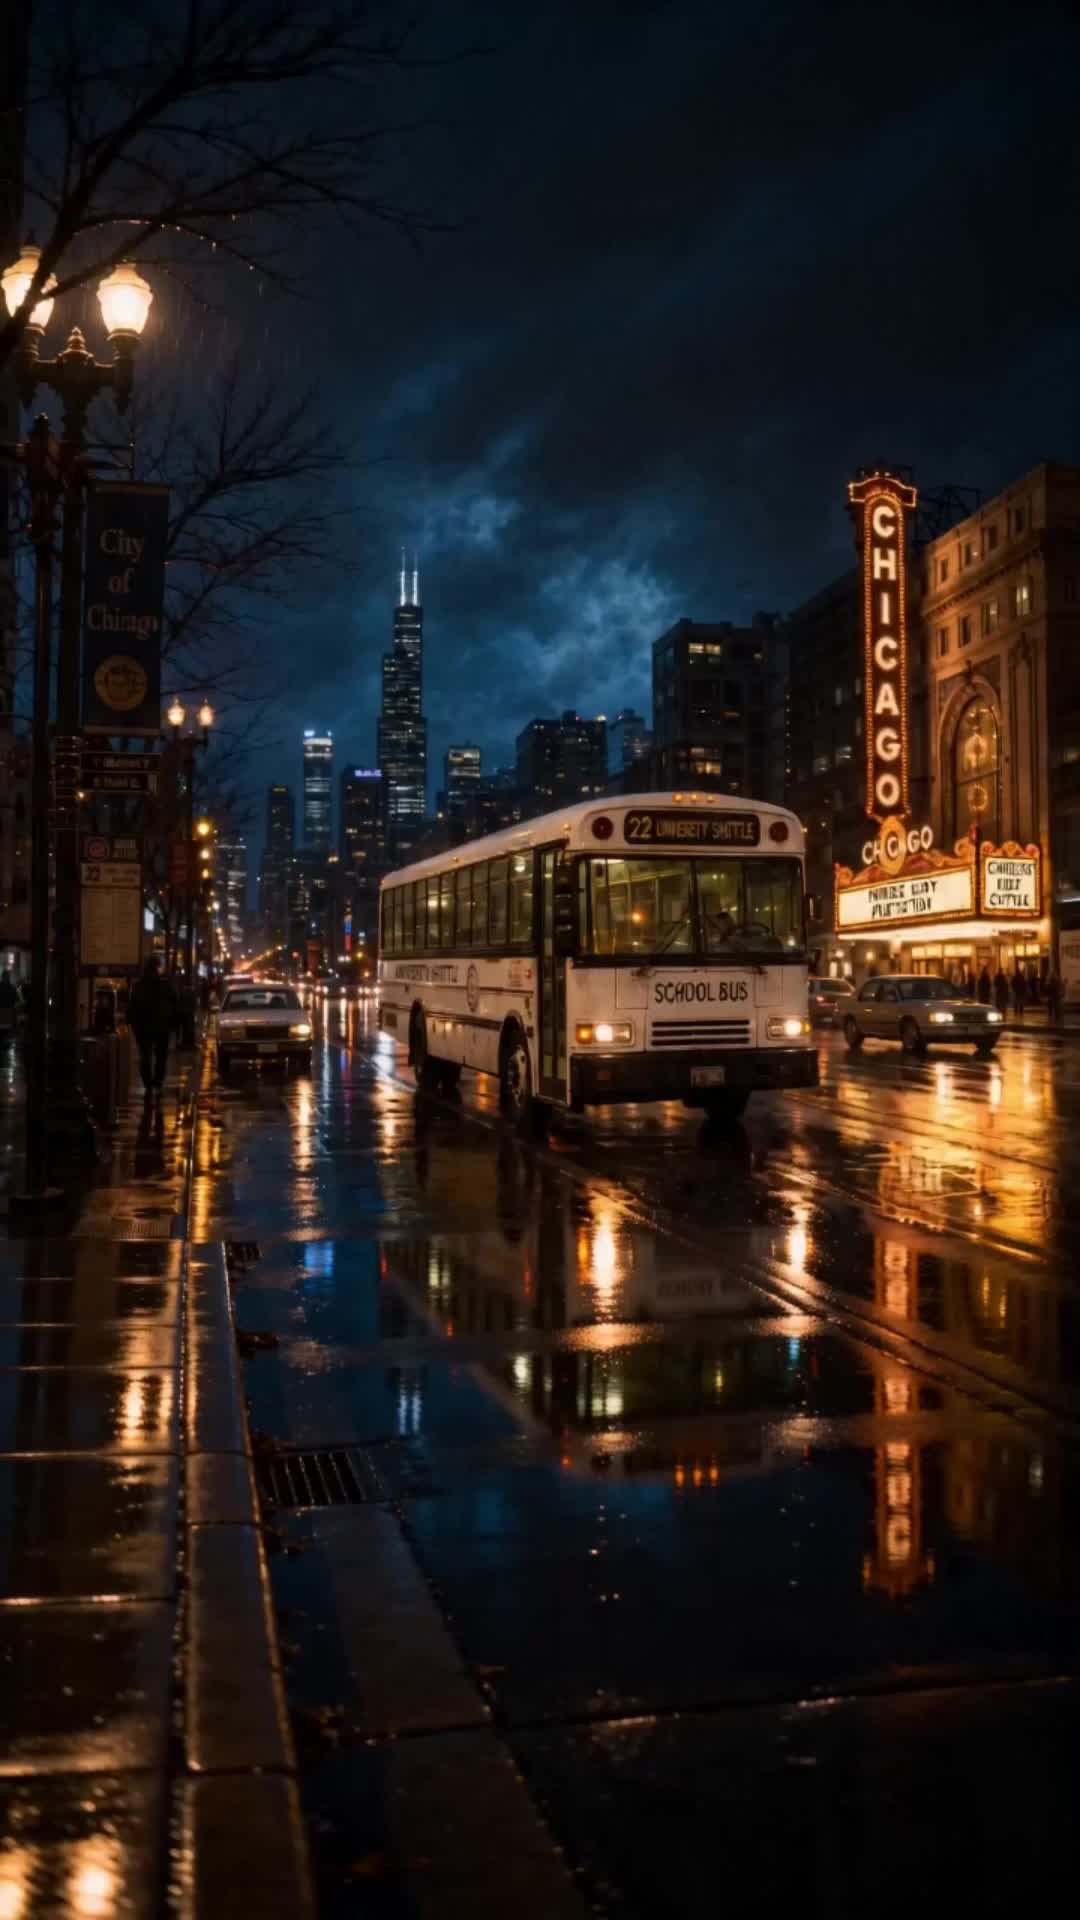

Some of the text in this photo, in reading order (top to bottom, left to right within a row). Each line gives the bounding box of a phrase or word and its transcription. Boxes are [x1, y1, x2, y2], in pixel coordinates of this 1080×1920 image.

[99, 528, 144, 562] City
[108, 567, 135, 593] of
[872, 505, 902, 807] CHICAGO
[629, 816, 653, 839] 22
[654, 981, 748, 1003] SCHOOL BUS
